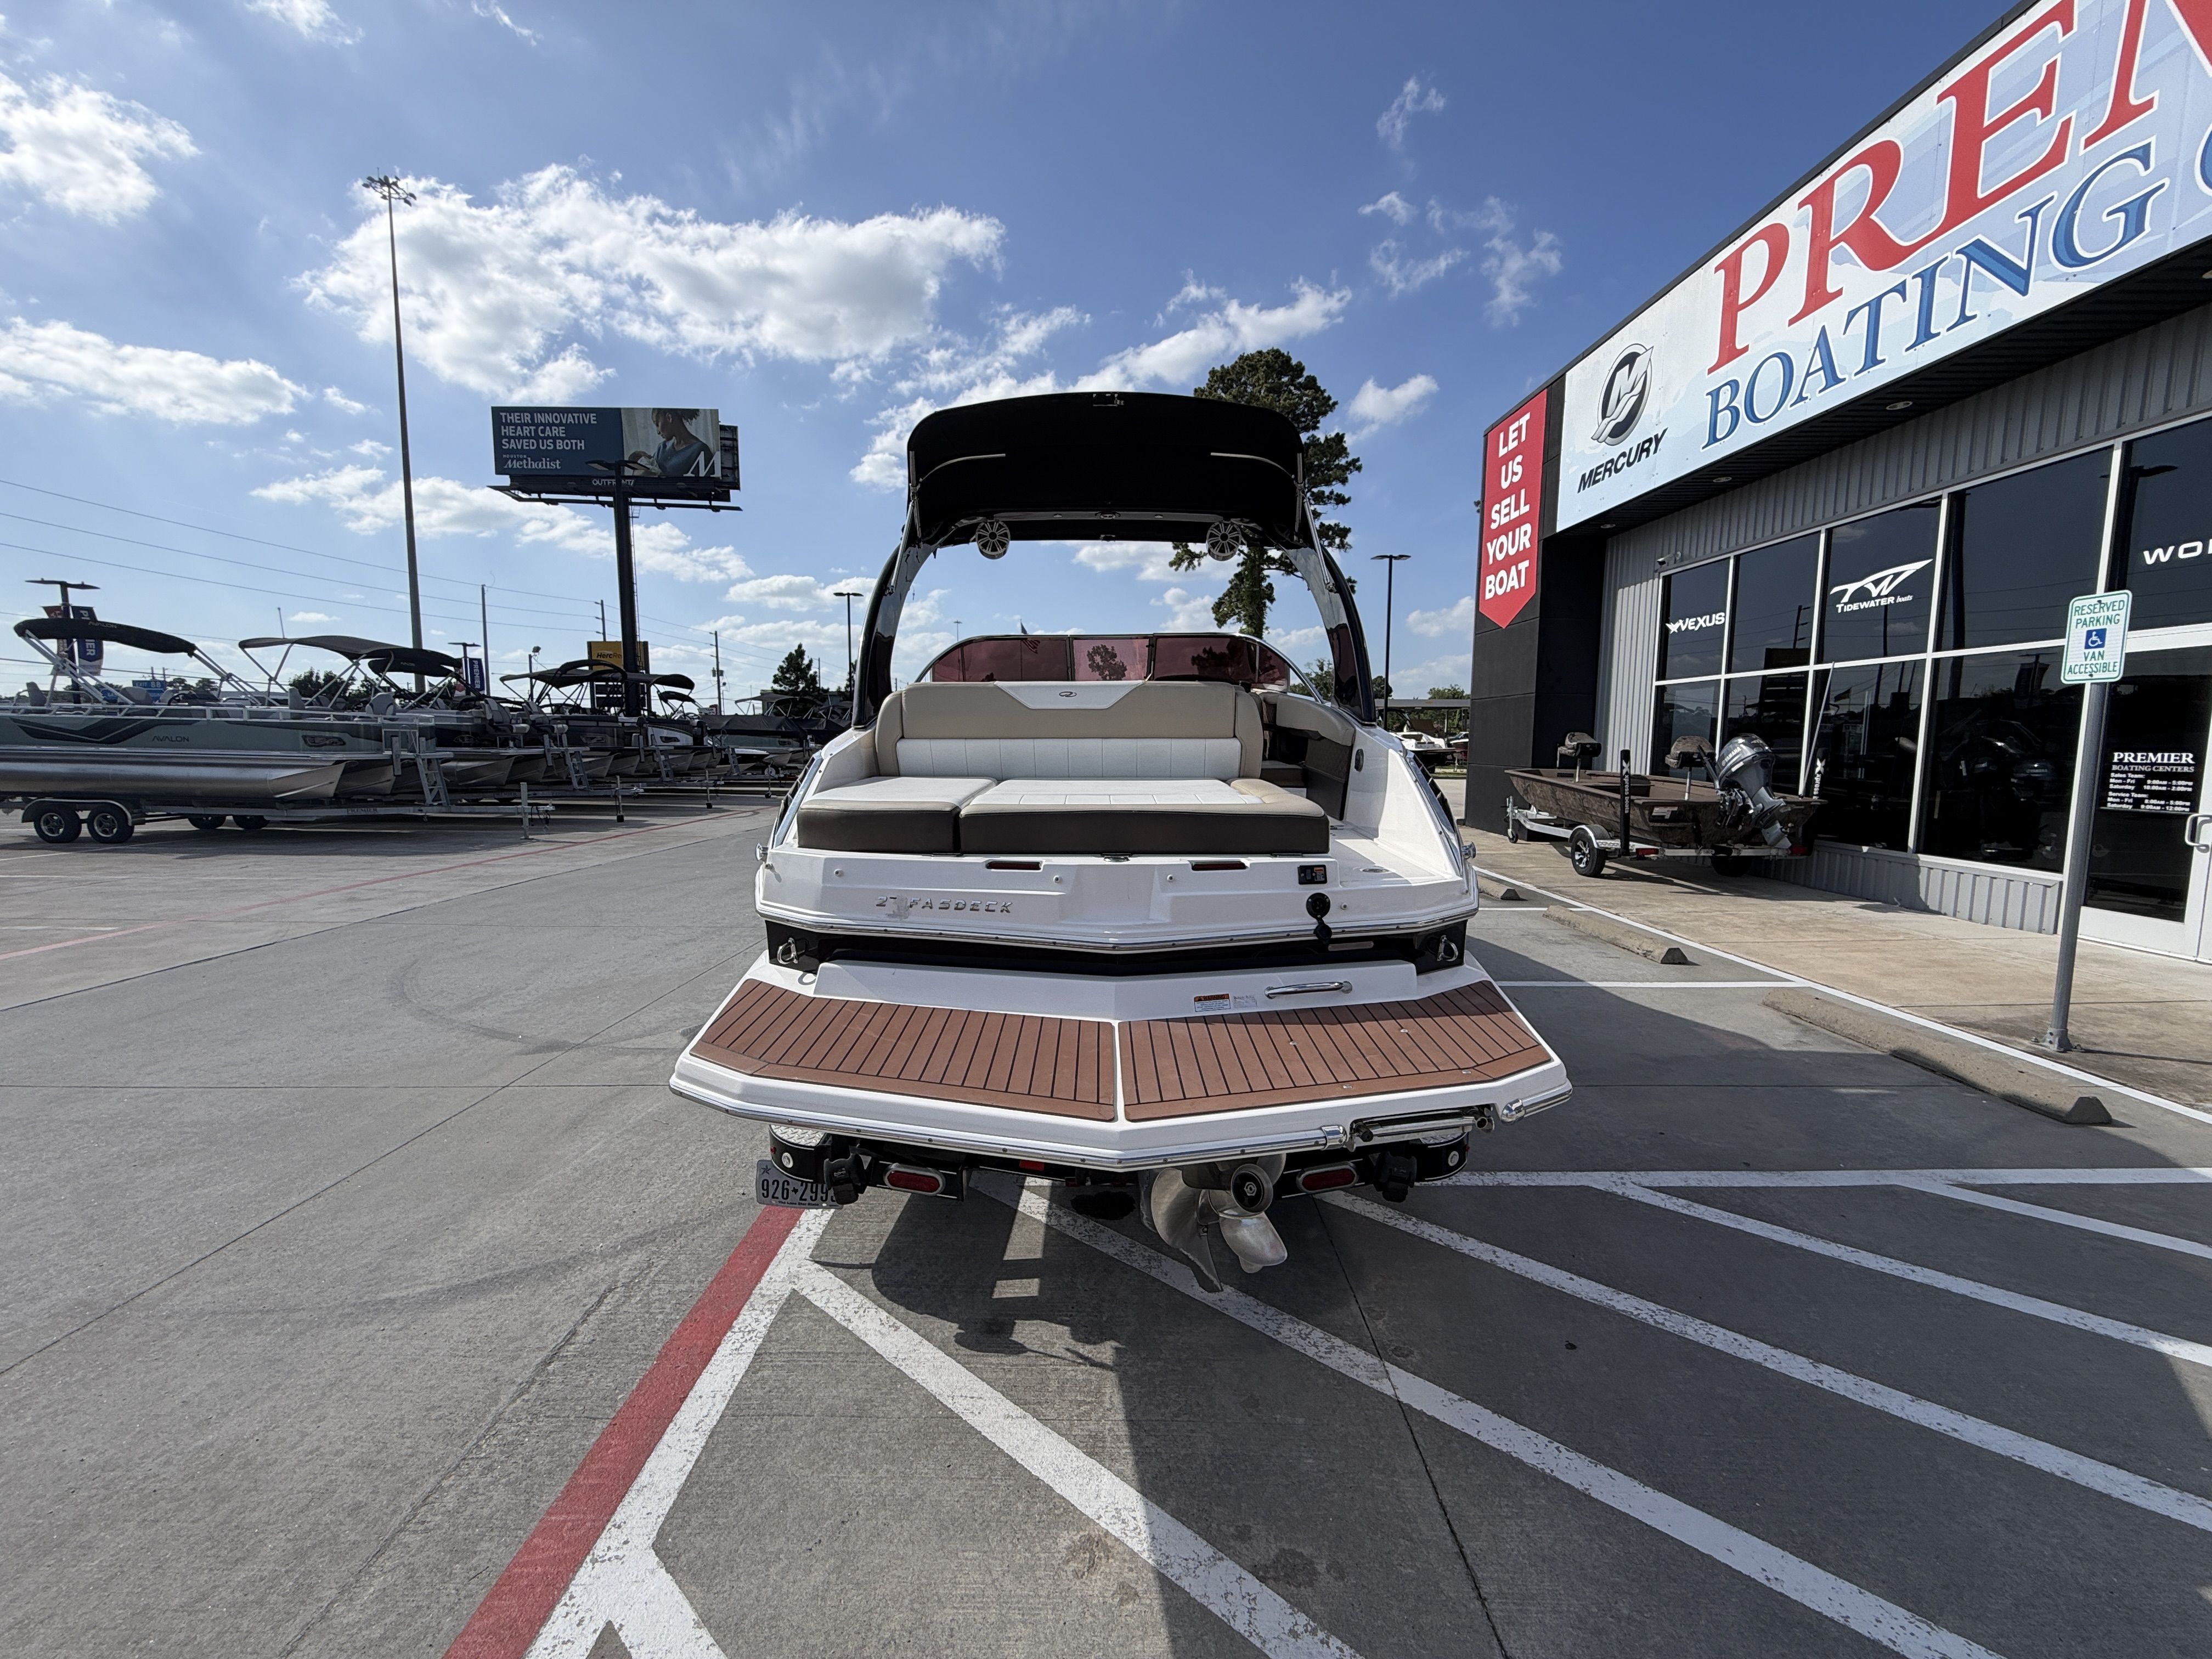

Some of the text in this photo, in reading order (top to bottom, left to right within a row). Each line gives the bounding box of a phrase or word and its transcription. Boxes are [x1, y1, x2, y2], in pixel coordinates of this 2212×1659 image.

[1701, 140, 2166, 450] BOATING
[500, 412, 597, 424] THEIR INNOVATIVE
[501, 426, 566, 437] HEART CARE
[1498, 411, 1531, 458] LET
[501, 439, 585, 450] SAVED US BOTH
[504, 457, 561, 469] Methodist
[1577, 427, 1668, 494] MERCURY
[1501, 454, 1523, 489] US
[1491, 488, 1530, 530] SELL
[1486, 523, 1532, 566] YOUR
[1485, 560, 1530, 600] BOAT
[1836, 595, 1914, 613] TIDEWATER boats
[2074, 600, 2125, 616] RESERVED
[1679, 612, 1725, 631] VEXUS
[2075, 614, 2120, 629] PARKING
[2084, 650, 2104, 662] VAN
[472, 660, 481, 689] PREMIER
[2067, 662, 2118, 675] ACCESSIBLE
[2112, 752, 2196, 764] PREMIER
[910, 896, 1013, 913] FASDECK
[761, 1179, 790, 1200] 926
